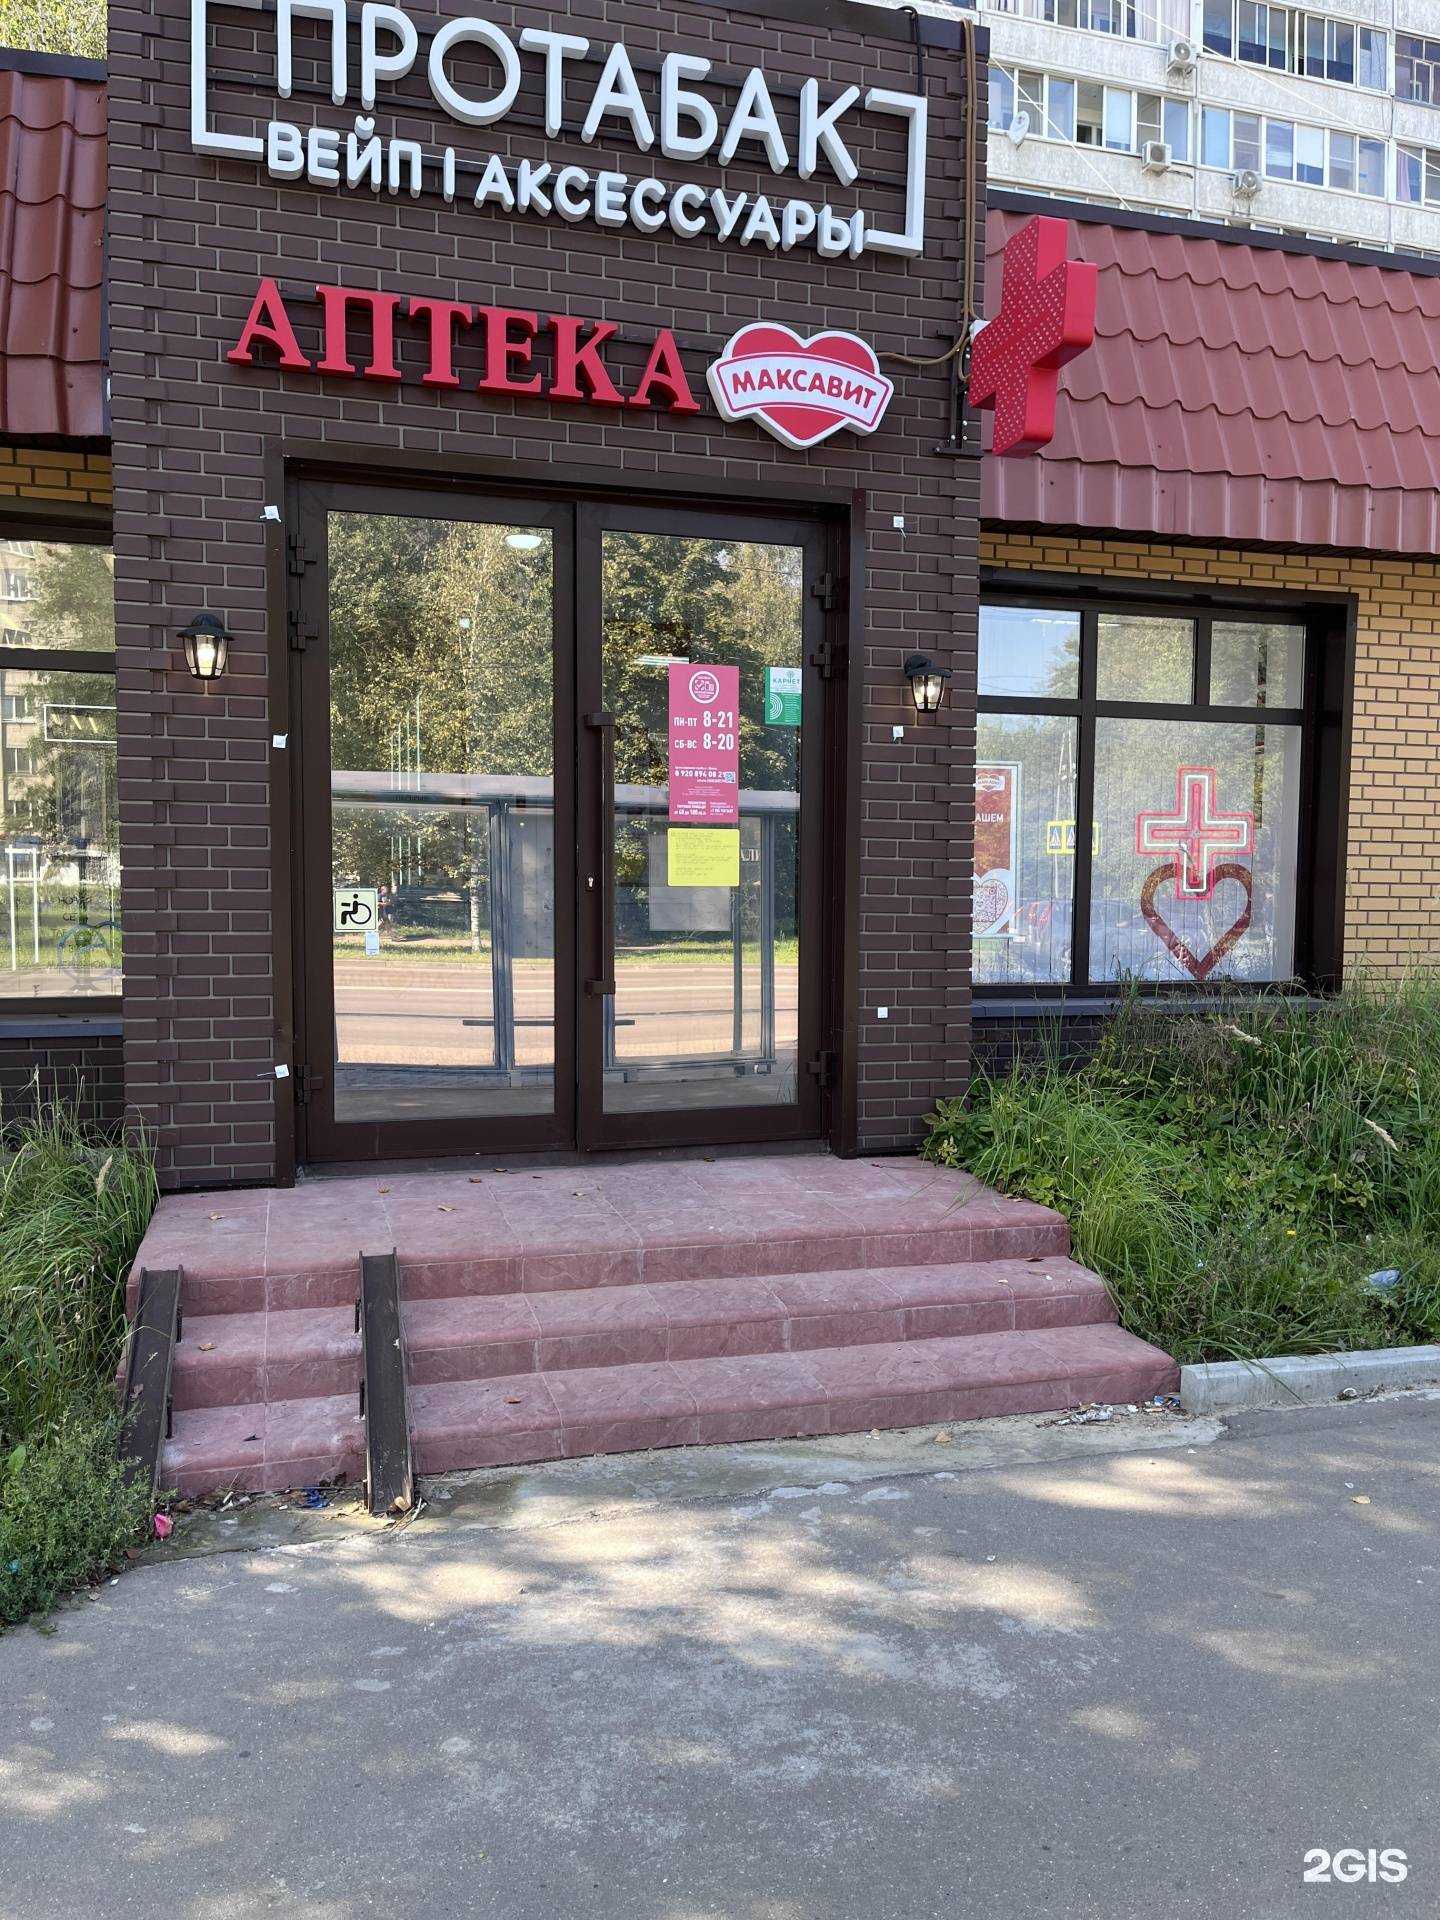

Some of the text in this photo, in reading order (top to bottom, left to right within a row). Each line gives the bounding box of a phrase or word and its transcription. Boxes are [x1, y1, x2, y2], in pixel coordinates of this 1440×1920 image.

[277, 0, 860, 186] ПРОТАБАК
[268, 115, 422, 199] ВЕЙП
[474, 154, 864, 259] АКСЕССУАРЫ
[227, 278, 700, 415] АПТЕКА
[732, 369, 877, 408] МАКСАВИТ
[674, 711, 733, 728] ПН-ПТ 8-21
[674, 733, 734, 750] СБ-ВС 8-20
[975, 813, 1004, 822] АШЕМ
